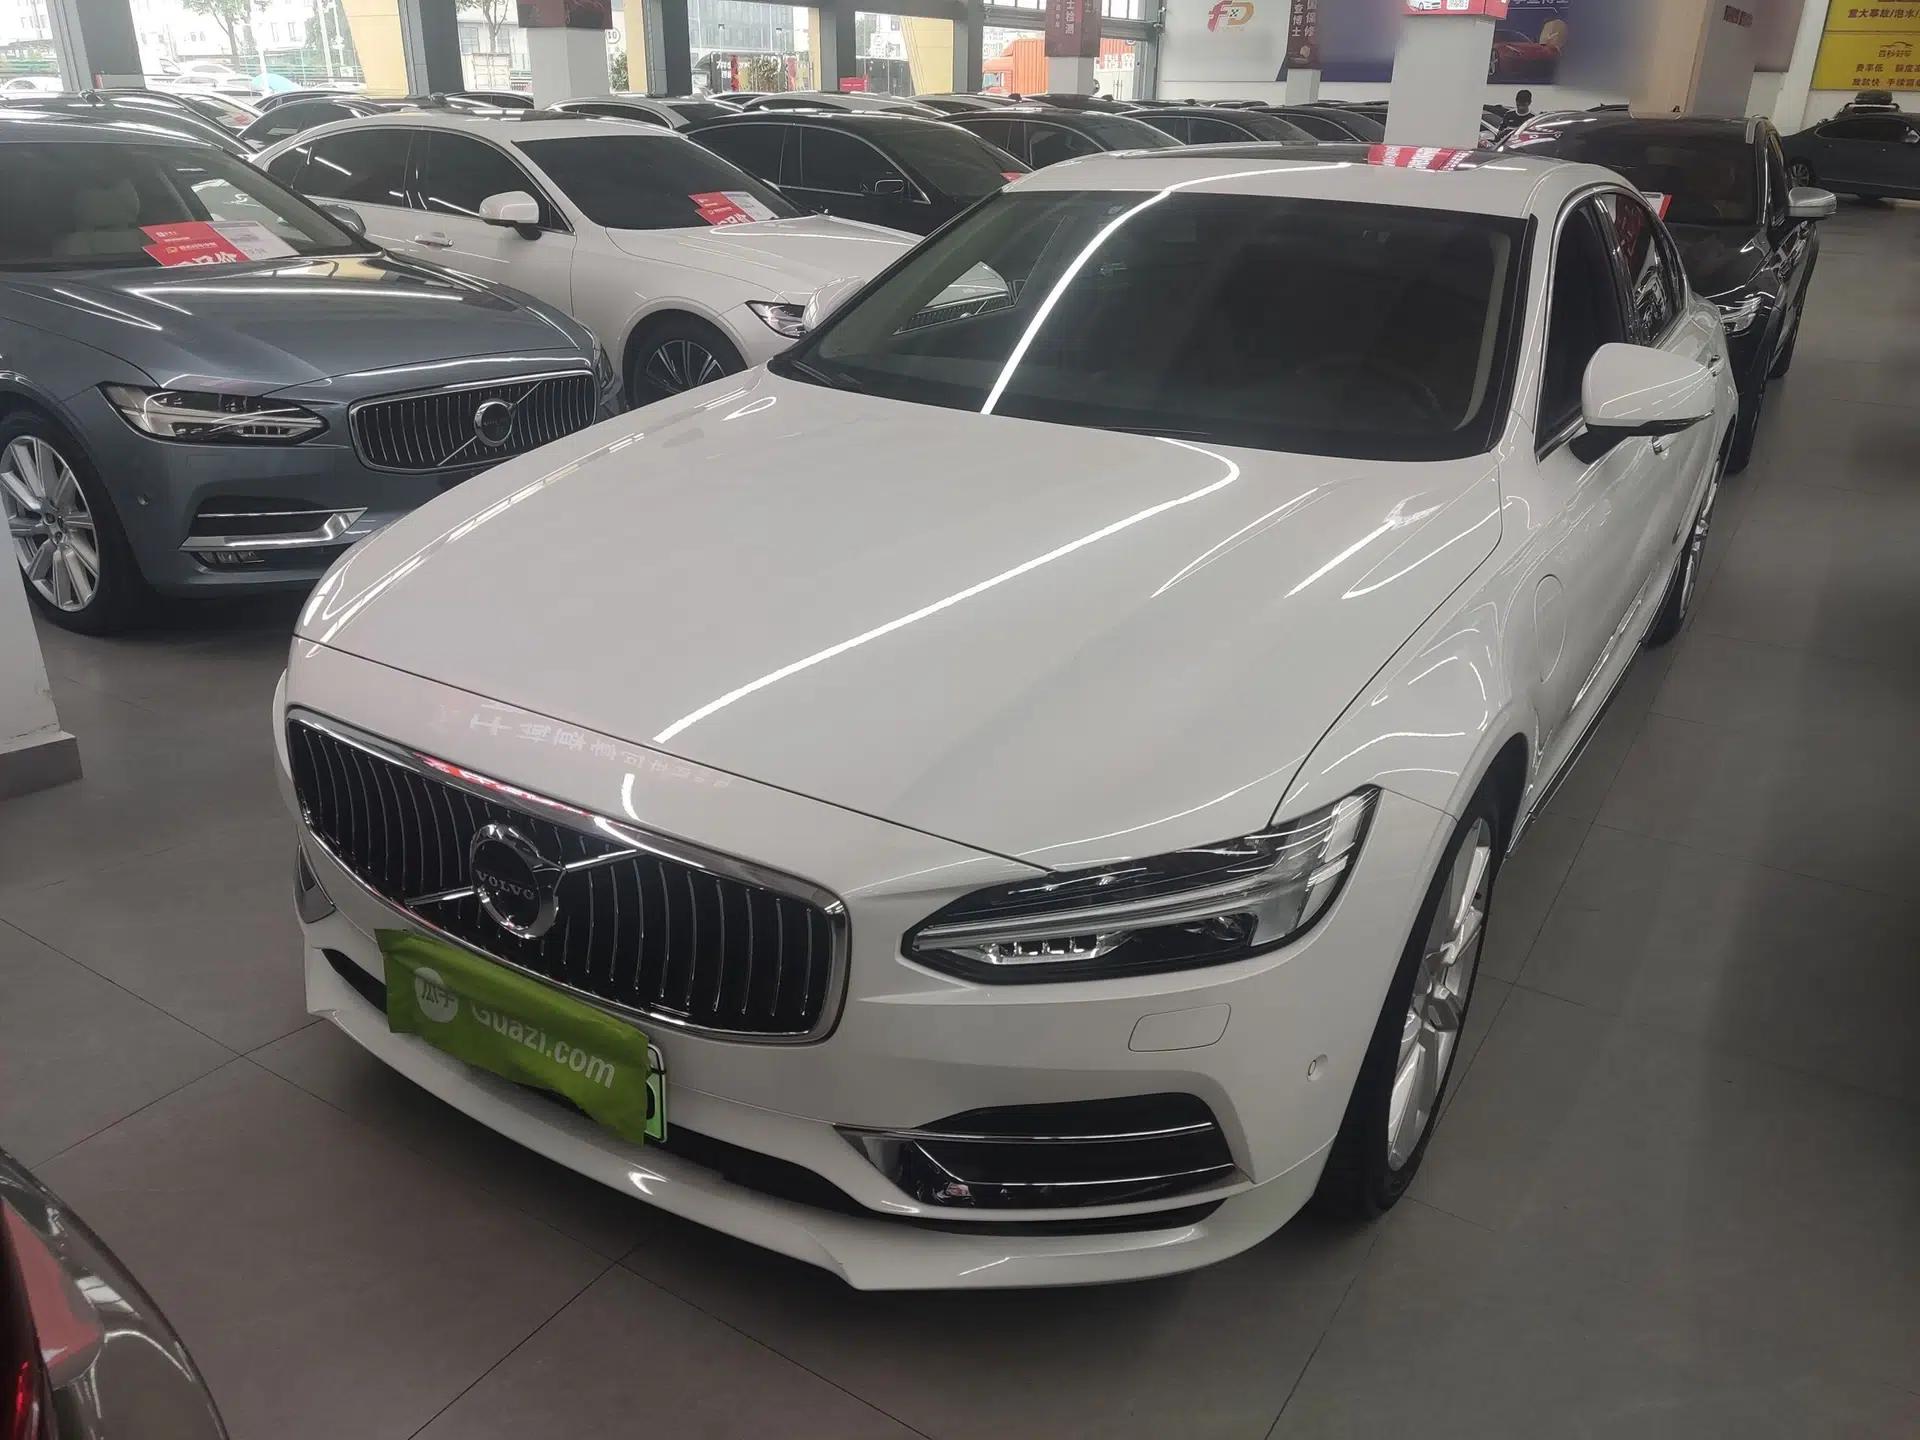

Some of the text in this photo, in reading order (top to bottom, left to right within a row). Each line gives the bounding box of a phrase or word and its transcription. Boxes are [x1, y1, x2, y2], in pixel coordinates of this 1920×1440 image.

[1291, 0, 1304, 37] 查博士
[476, 869, 535, 899] VOLVO
[472, 1003, 615, 1089] Guazi.com
